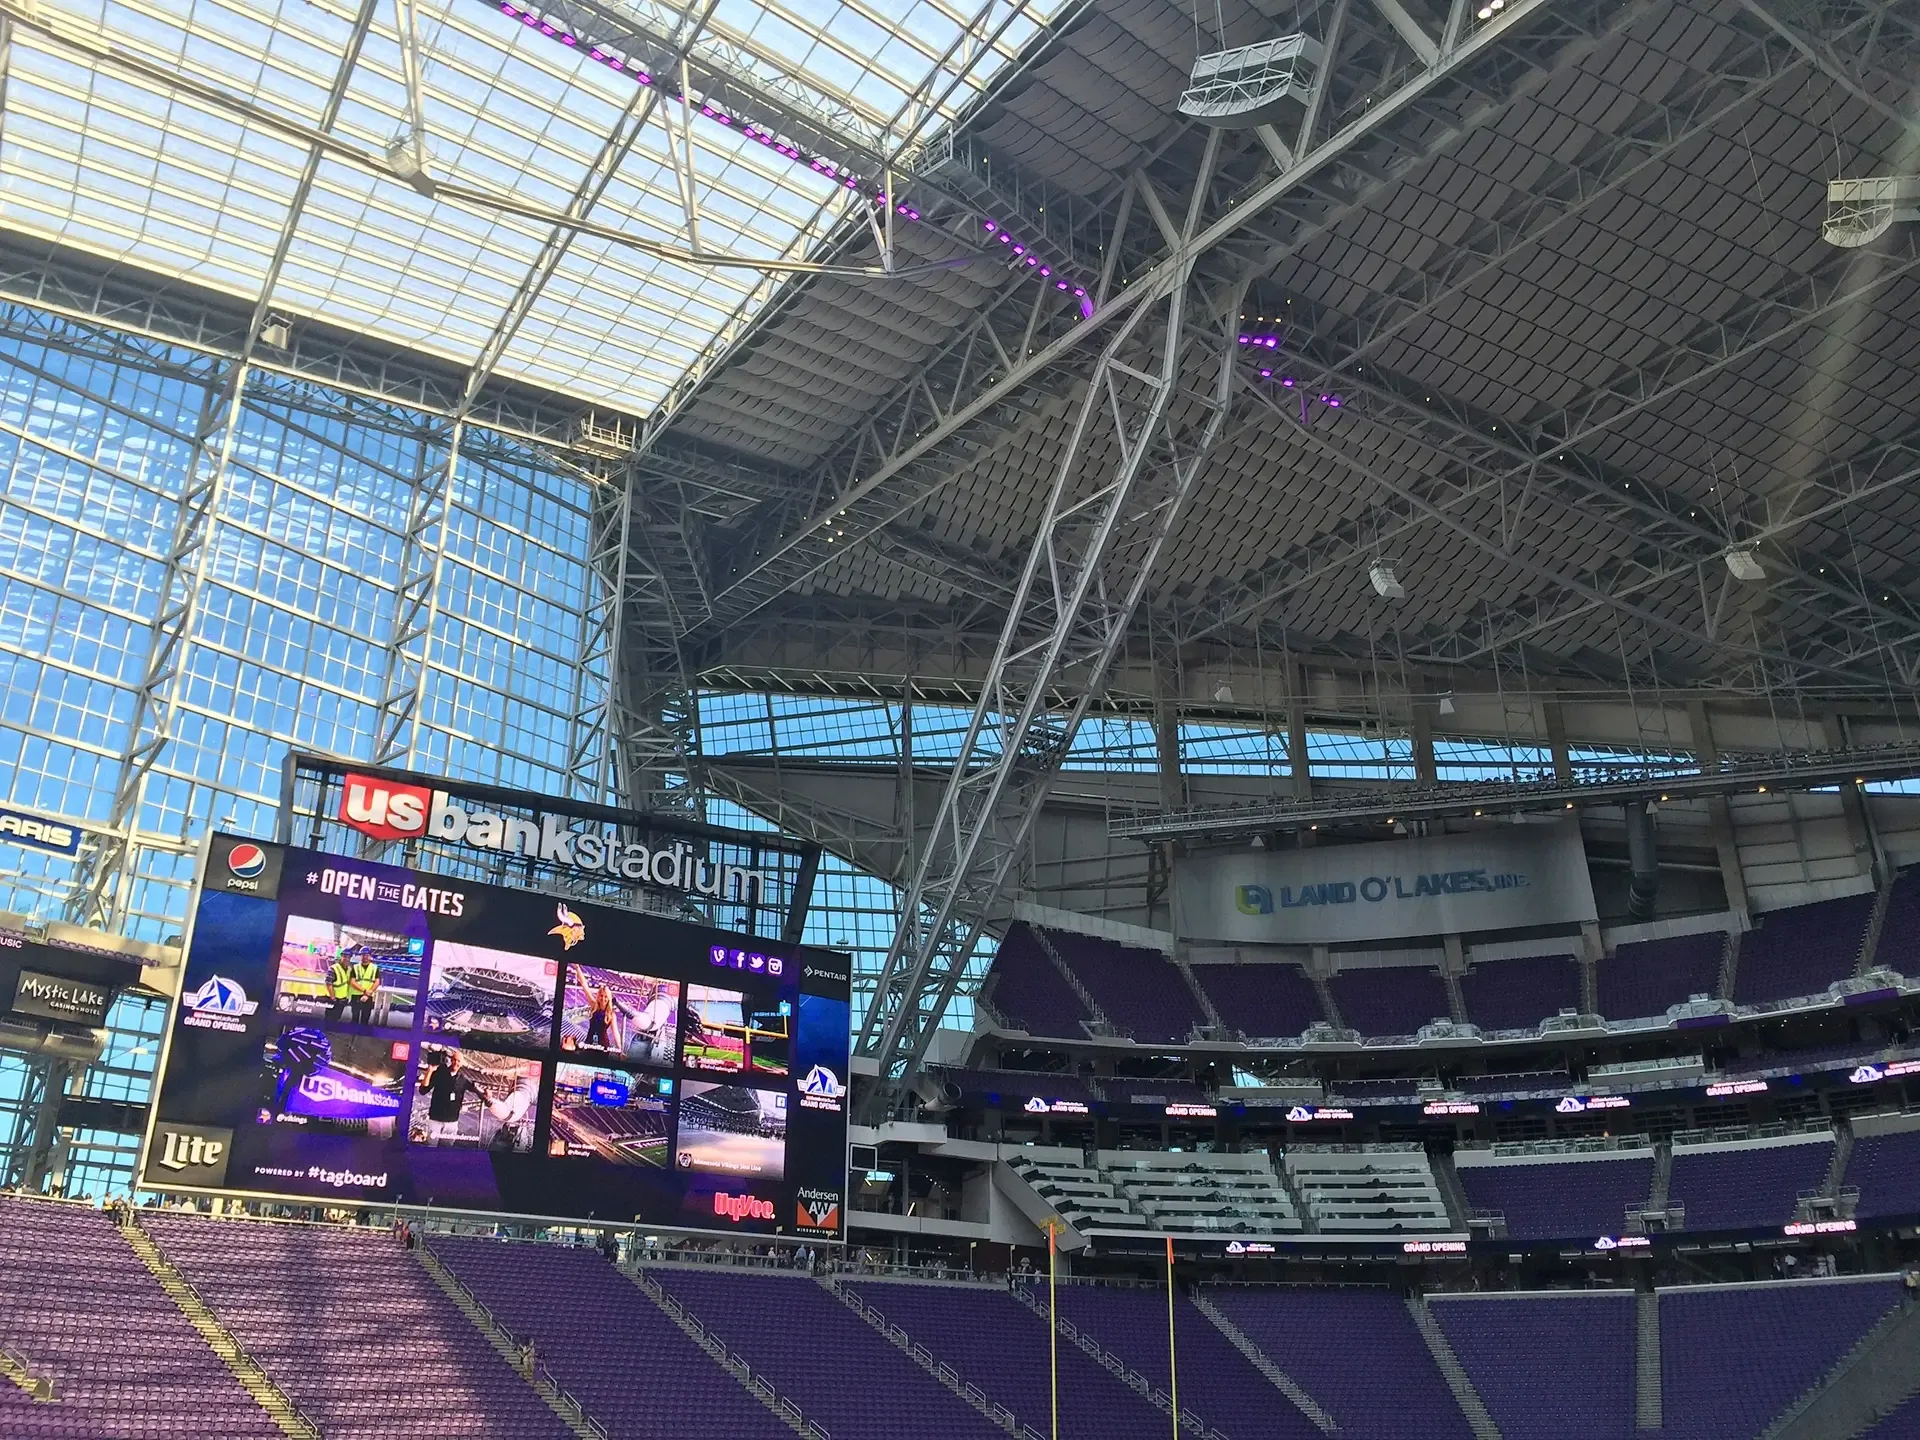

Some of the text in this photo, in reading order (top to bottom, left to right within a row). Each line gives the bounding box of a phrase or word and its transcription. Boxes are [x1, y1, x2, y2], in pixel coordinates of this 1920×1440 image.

[226, 877, 259, 891] pepsi
[377, 885, 400, 899] THE
[400, 884, 465, 917] GATES
[1280, 881, 1356, 908] LAND
[813, 969, 847, 982] PENTAIR
[183, 1016, 247, 1033] GRAND OPENING
[1706, 1086, 1734, 1097] GRAND
[1734, 1081, 1768, 1093] OPENING
[800, 1098, 819, 1109] GRAND
[818, 1101, 842, 1112] OPENING
[1165, 1106, 1217, 1117] GRAND OPENING
[1423, 1105, 1449, 1115] GRAND
[1449, 1103, 1480, 1114] OPENING
[159, 1132, 223, 1170] Lite
[254, 1166, 388, 1188] POWERED BY #tagboard
[797, 1186, 839, 1202] Andersen
[1784, 1220, 1857, 1236] GRAND OPENING
[1404, 1241, 1467, 1253] GRAND OPENING
